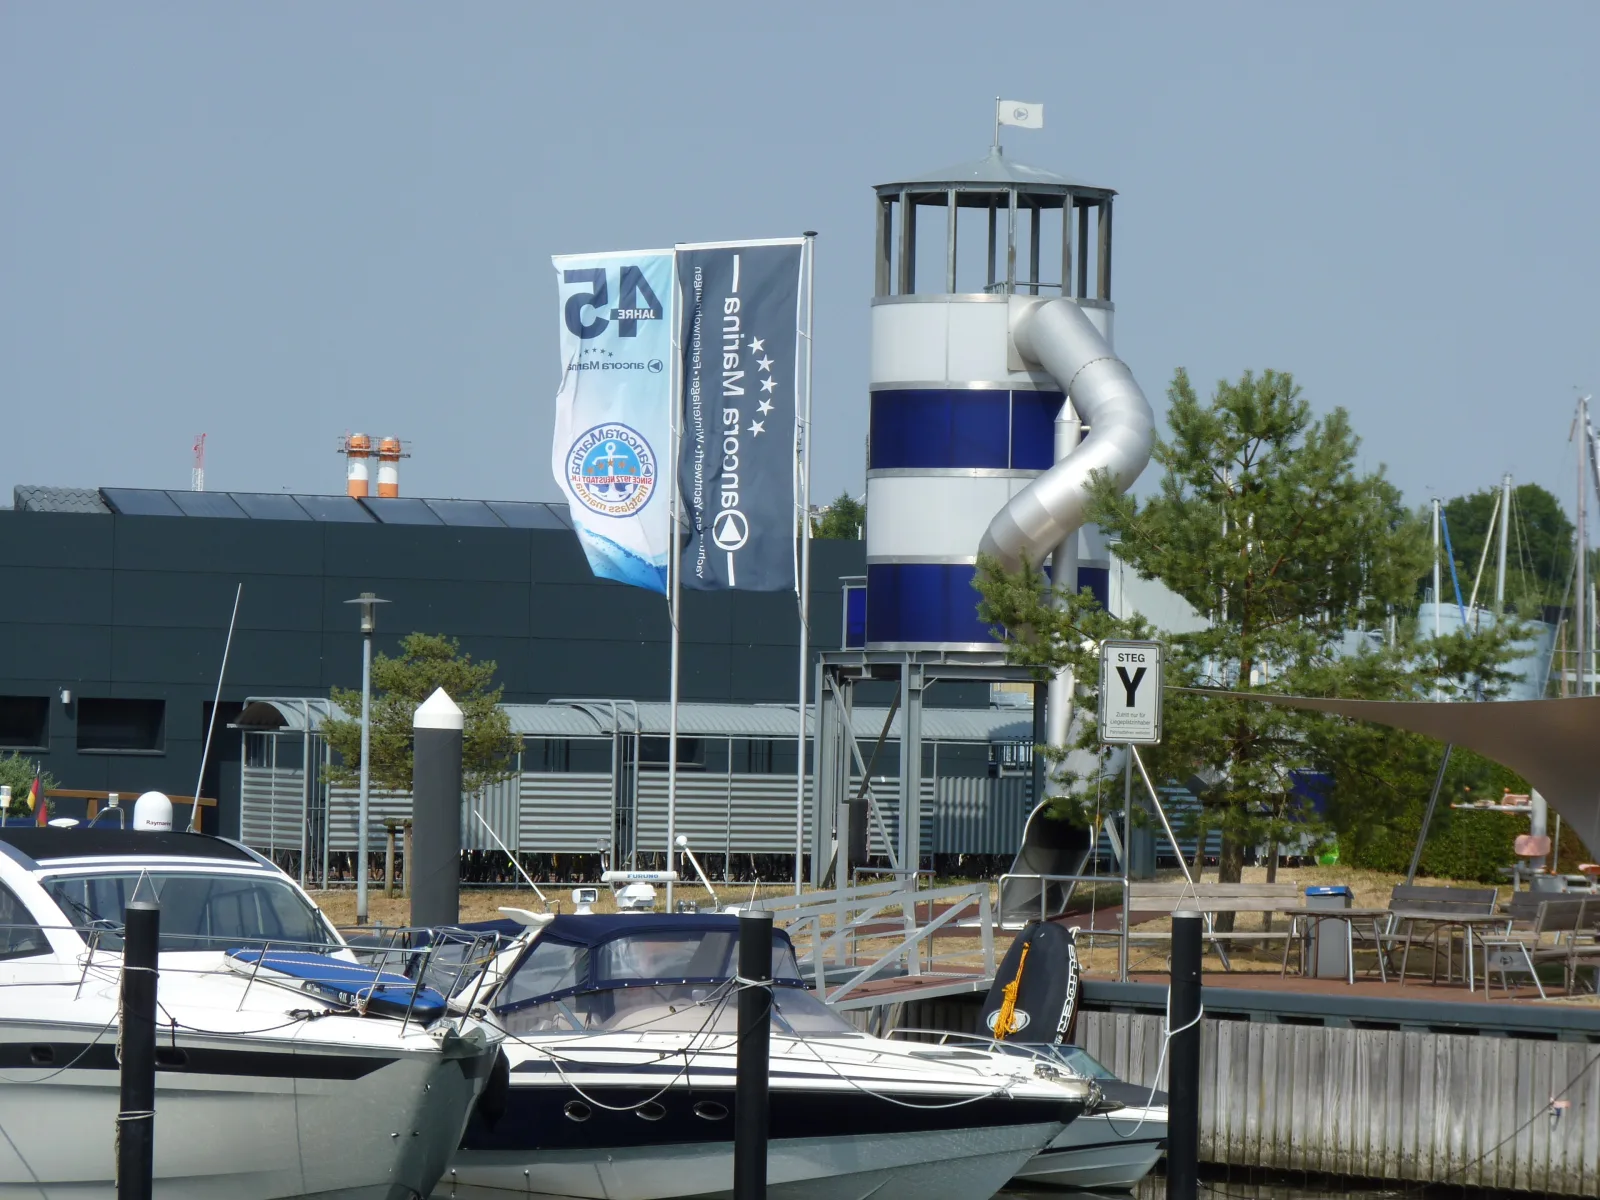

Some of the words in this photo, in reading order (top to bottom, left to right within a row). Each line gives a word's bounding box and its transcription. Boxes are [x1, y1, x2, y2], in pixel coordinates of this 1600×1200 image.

[1117, 652, 1146, 663] STEG
[1116, 666, 1147, 707] Y
[1056, 943, 1078, 1033] SLIDER
